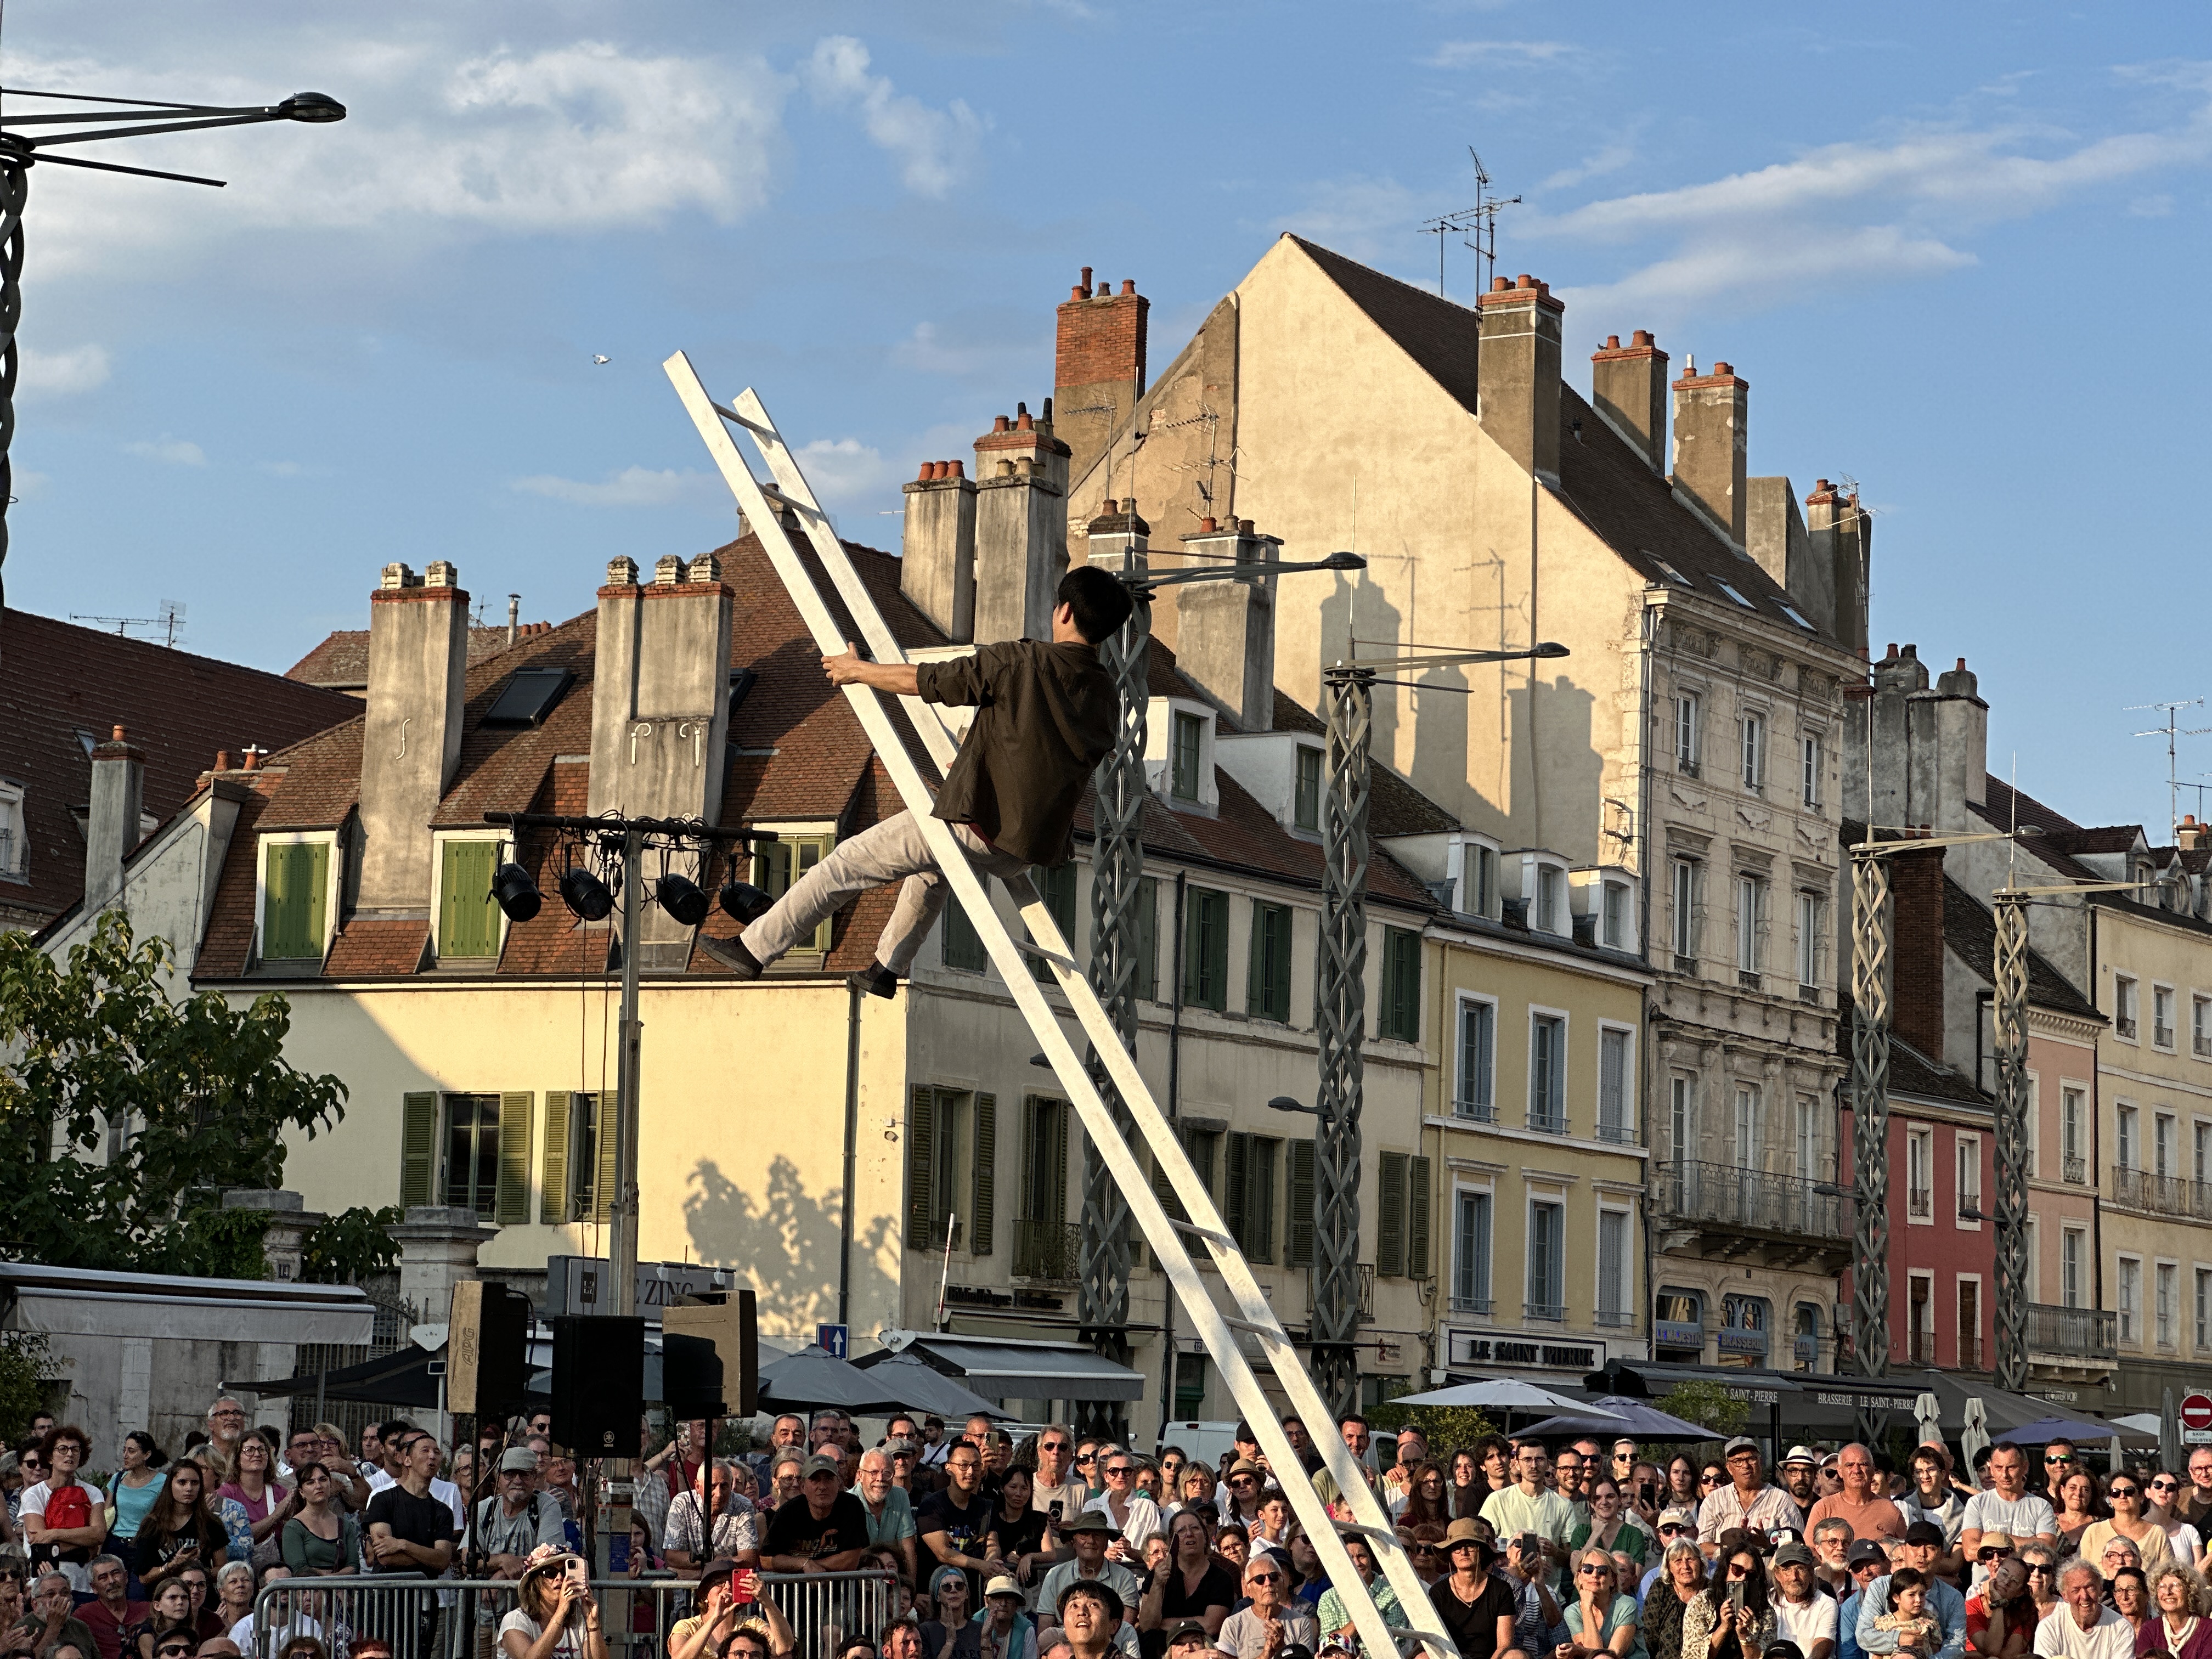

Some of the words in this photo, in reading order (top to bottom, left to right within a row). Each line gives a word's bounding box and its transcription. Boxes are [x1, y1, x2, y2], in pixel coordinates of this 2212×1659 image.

[1720, 1334, 1763, 1349] BRASSERIE
[1470, 1340, 1491, 1359] LE
[1494, 1341, 1539, 1363] SAINT
[1543, 1345, 1594, 1367] PIERRE
[1818, 1393, 1853, 1406] BRASSERIE
[1860, 1396, 1868, 1407] LE
[1871, 1397, 1914, 1410] SAINT-PIERRE
